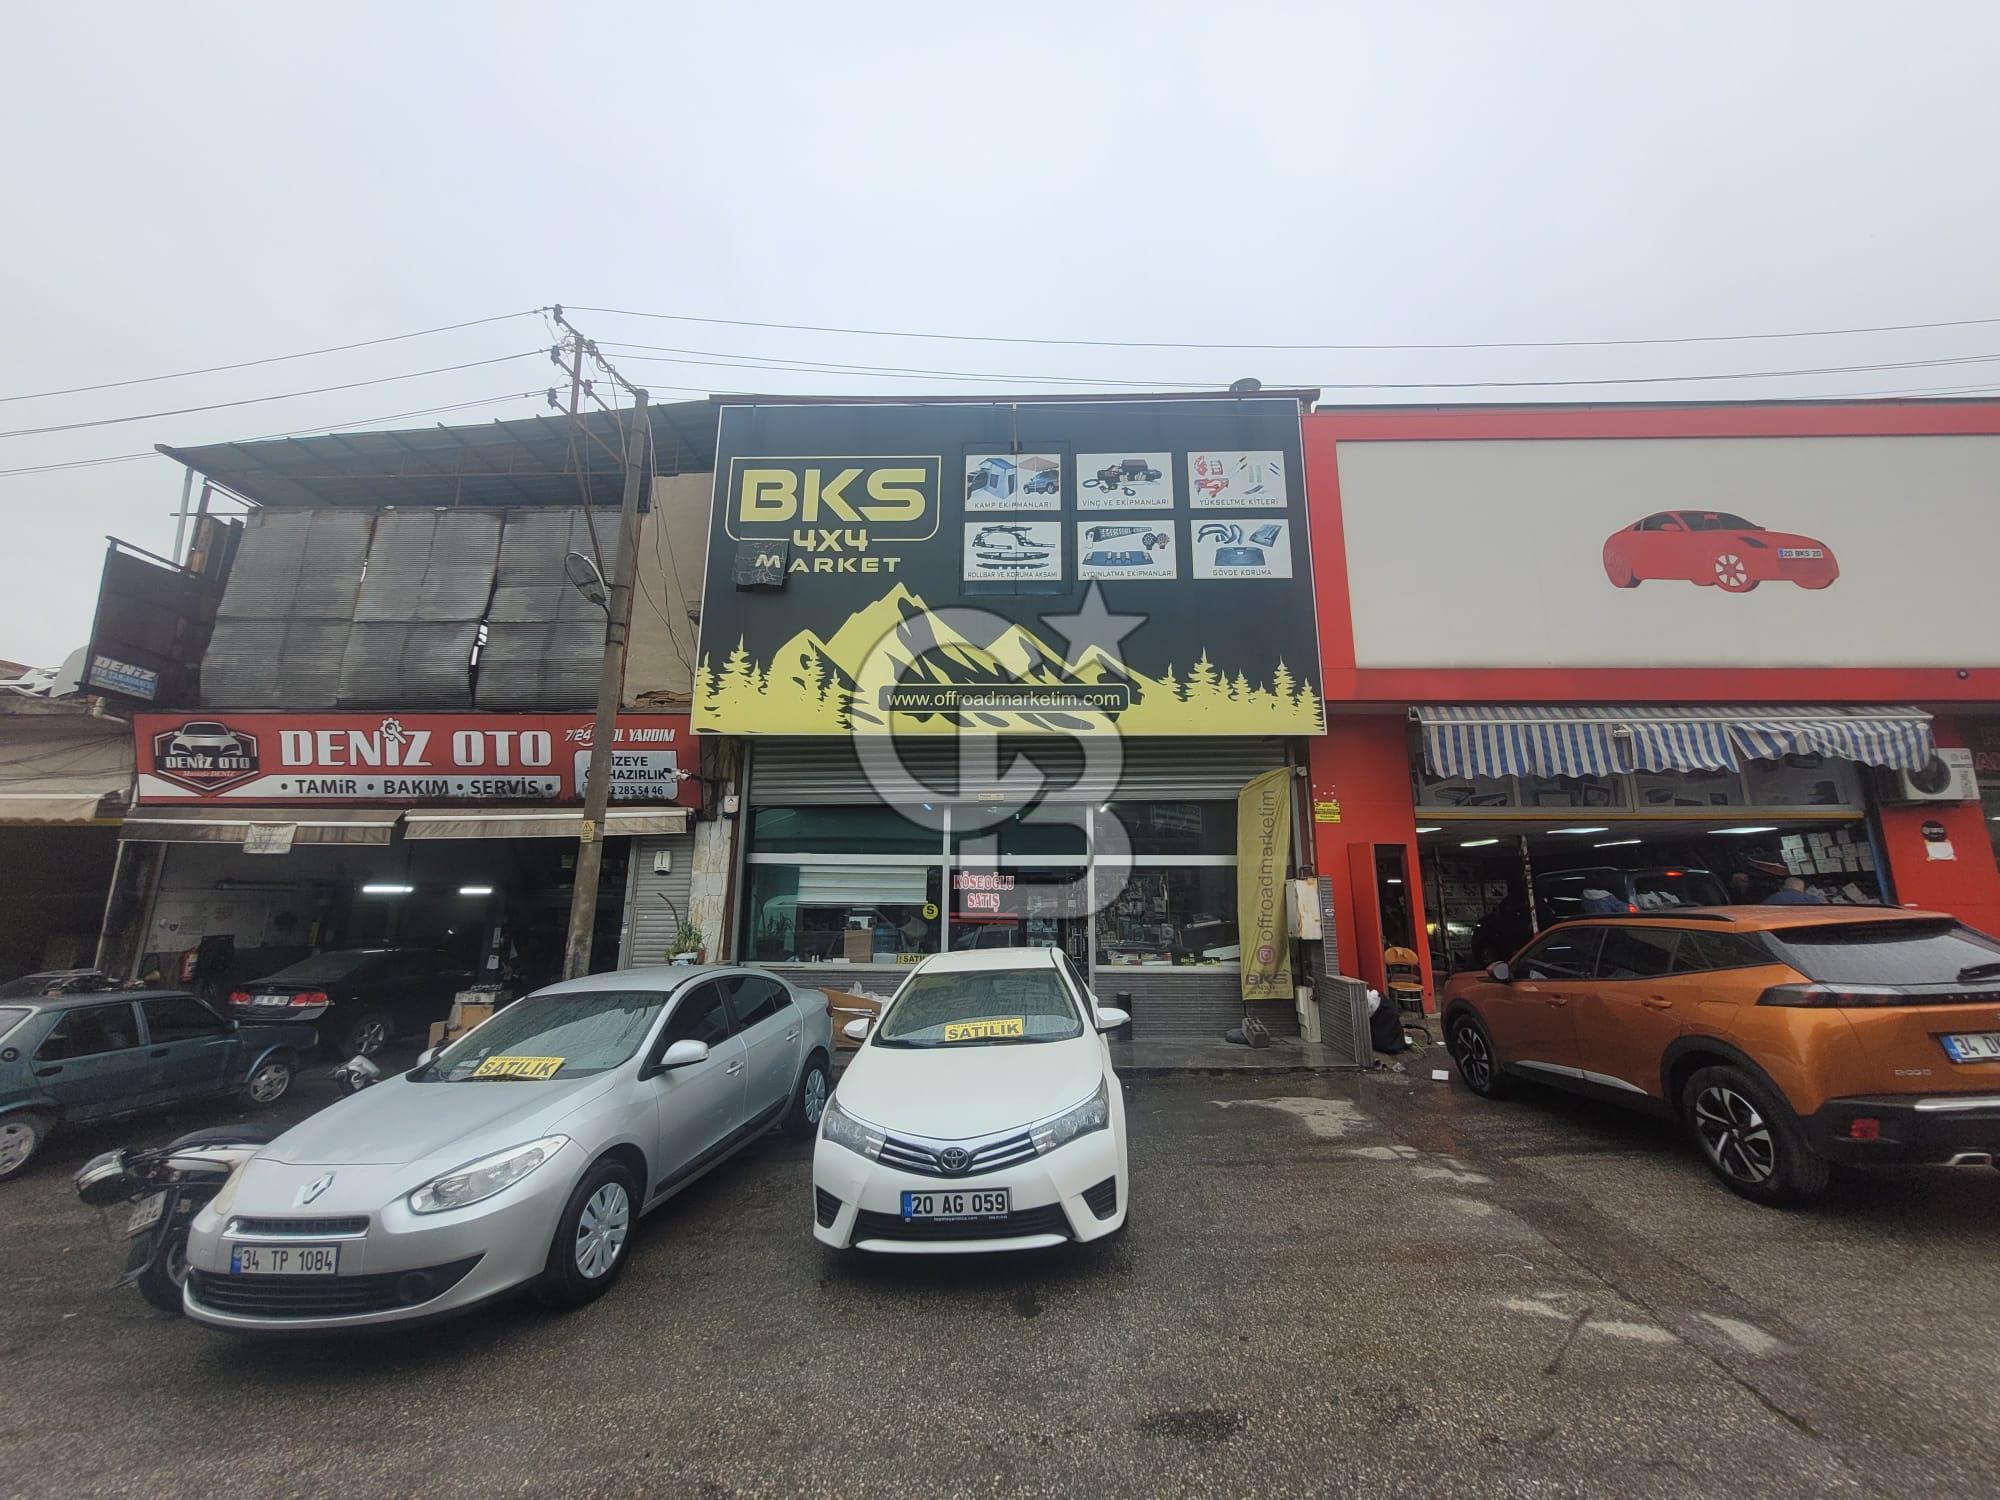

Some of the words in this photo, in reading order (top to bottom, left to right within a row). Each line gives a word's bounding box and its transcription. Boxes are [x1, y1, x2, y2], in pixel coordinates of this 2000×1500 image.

[740, 469, 926, 522] BKS
[1200, 498, 1245, 506] YÜKSELTME
[755, 554, 901, 573] MARKET
[887, 690, 1121, 706] www.offroadmarketim.com
[565, 729, 592, 741] 7/24
[629, 729, 676, 742] YARDIM
[452, 730, 552, 766] OTO
[219, 757, 250, 769] OTO
[384, 780, 449, 795] BAKIM
[470, 777, 539, 795] SERVİS
[618, 786, 637, 795] 285
[638, 786, 649, 795] 54
[651, 786, 663, 795] 46
[1257, 790, 1276, 942] offroadmarketim
[926, 905, 935, 915] S
[968, 893, 1000, 912] SATIŞ
[948, 1024, 1019, 1039] SATILIK
[1952, 1037, 1980, 1056] 34
[479, 1062, 557, 1076] SATILIK
[912, 1196, 933, 1214] 20
[942, 1195, 964, 1214] AG
[972, 1193, 1006, 1213] 059
[243, 1250, 259, 1270] 34
[272, 1250, 289, 1271] TP
[299, 1250, 332, 1272] 1084
